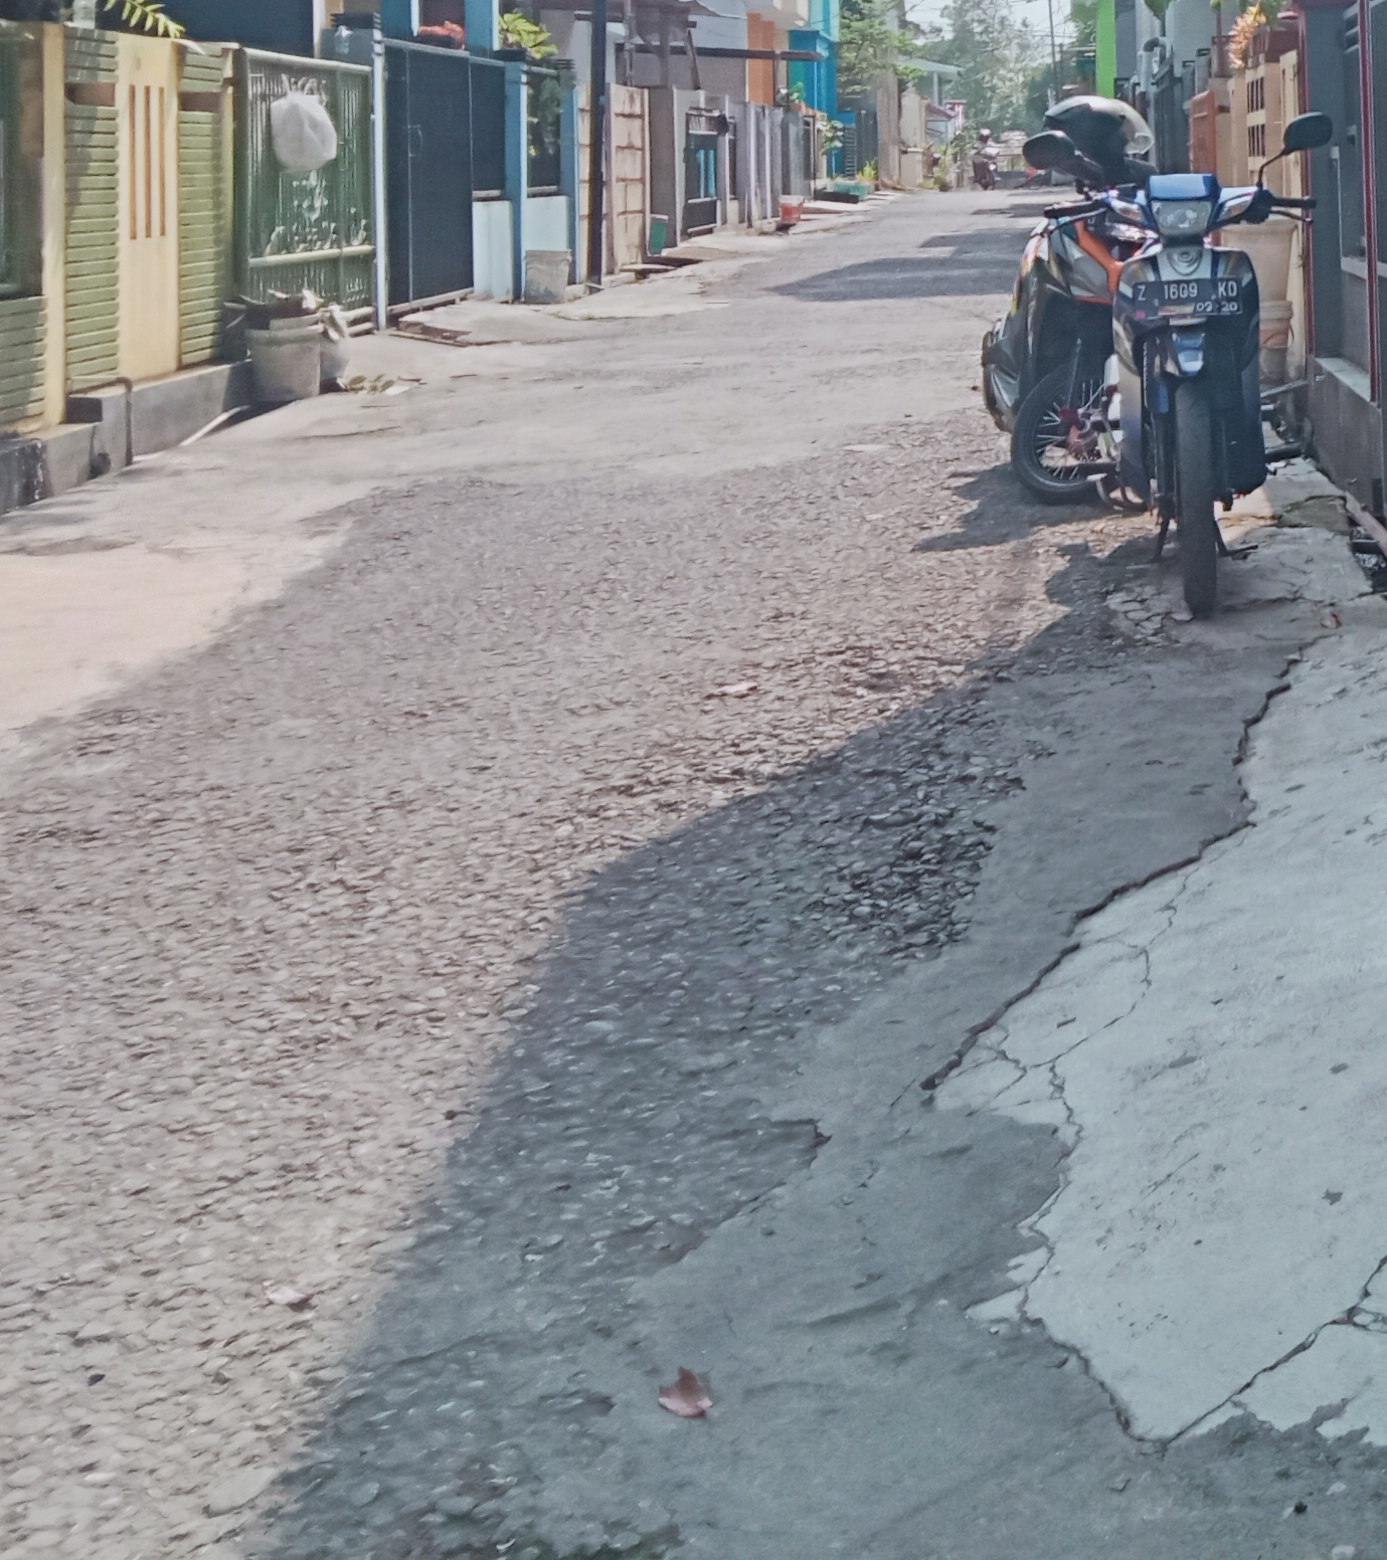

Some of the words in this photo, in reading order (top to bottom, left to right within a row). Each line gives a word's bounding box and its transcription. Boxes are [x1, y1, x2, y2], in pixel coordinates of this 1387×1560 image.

[1137, 285, 1147, 301] Z
[1163, 281, 1199, 300] 1609
[1217, 280, 1238, 298] KD
